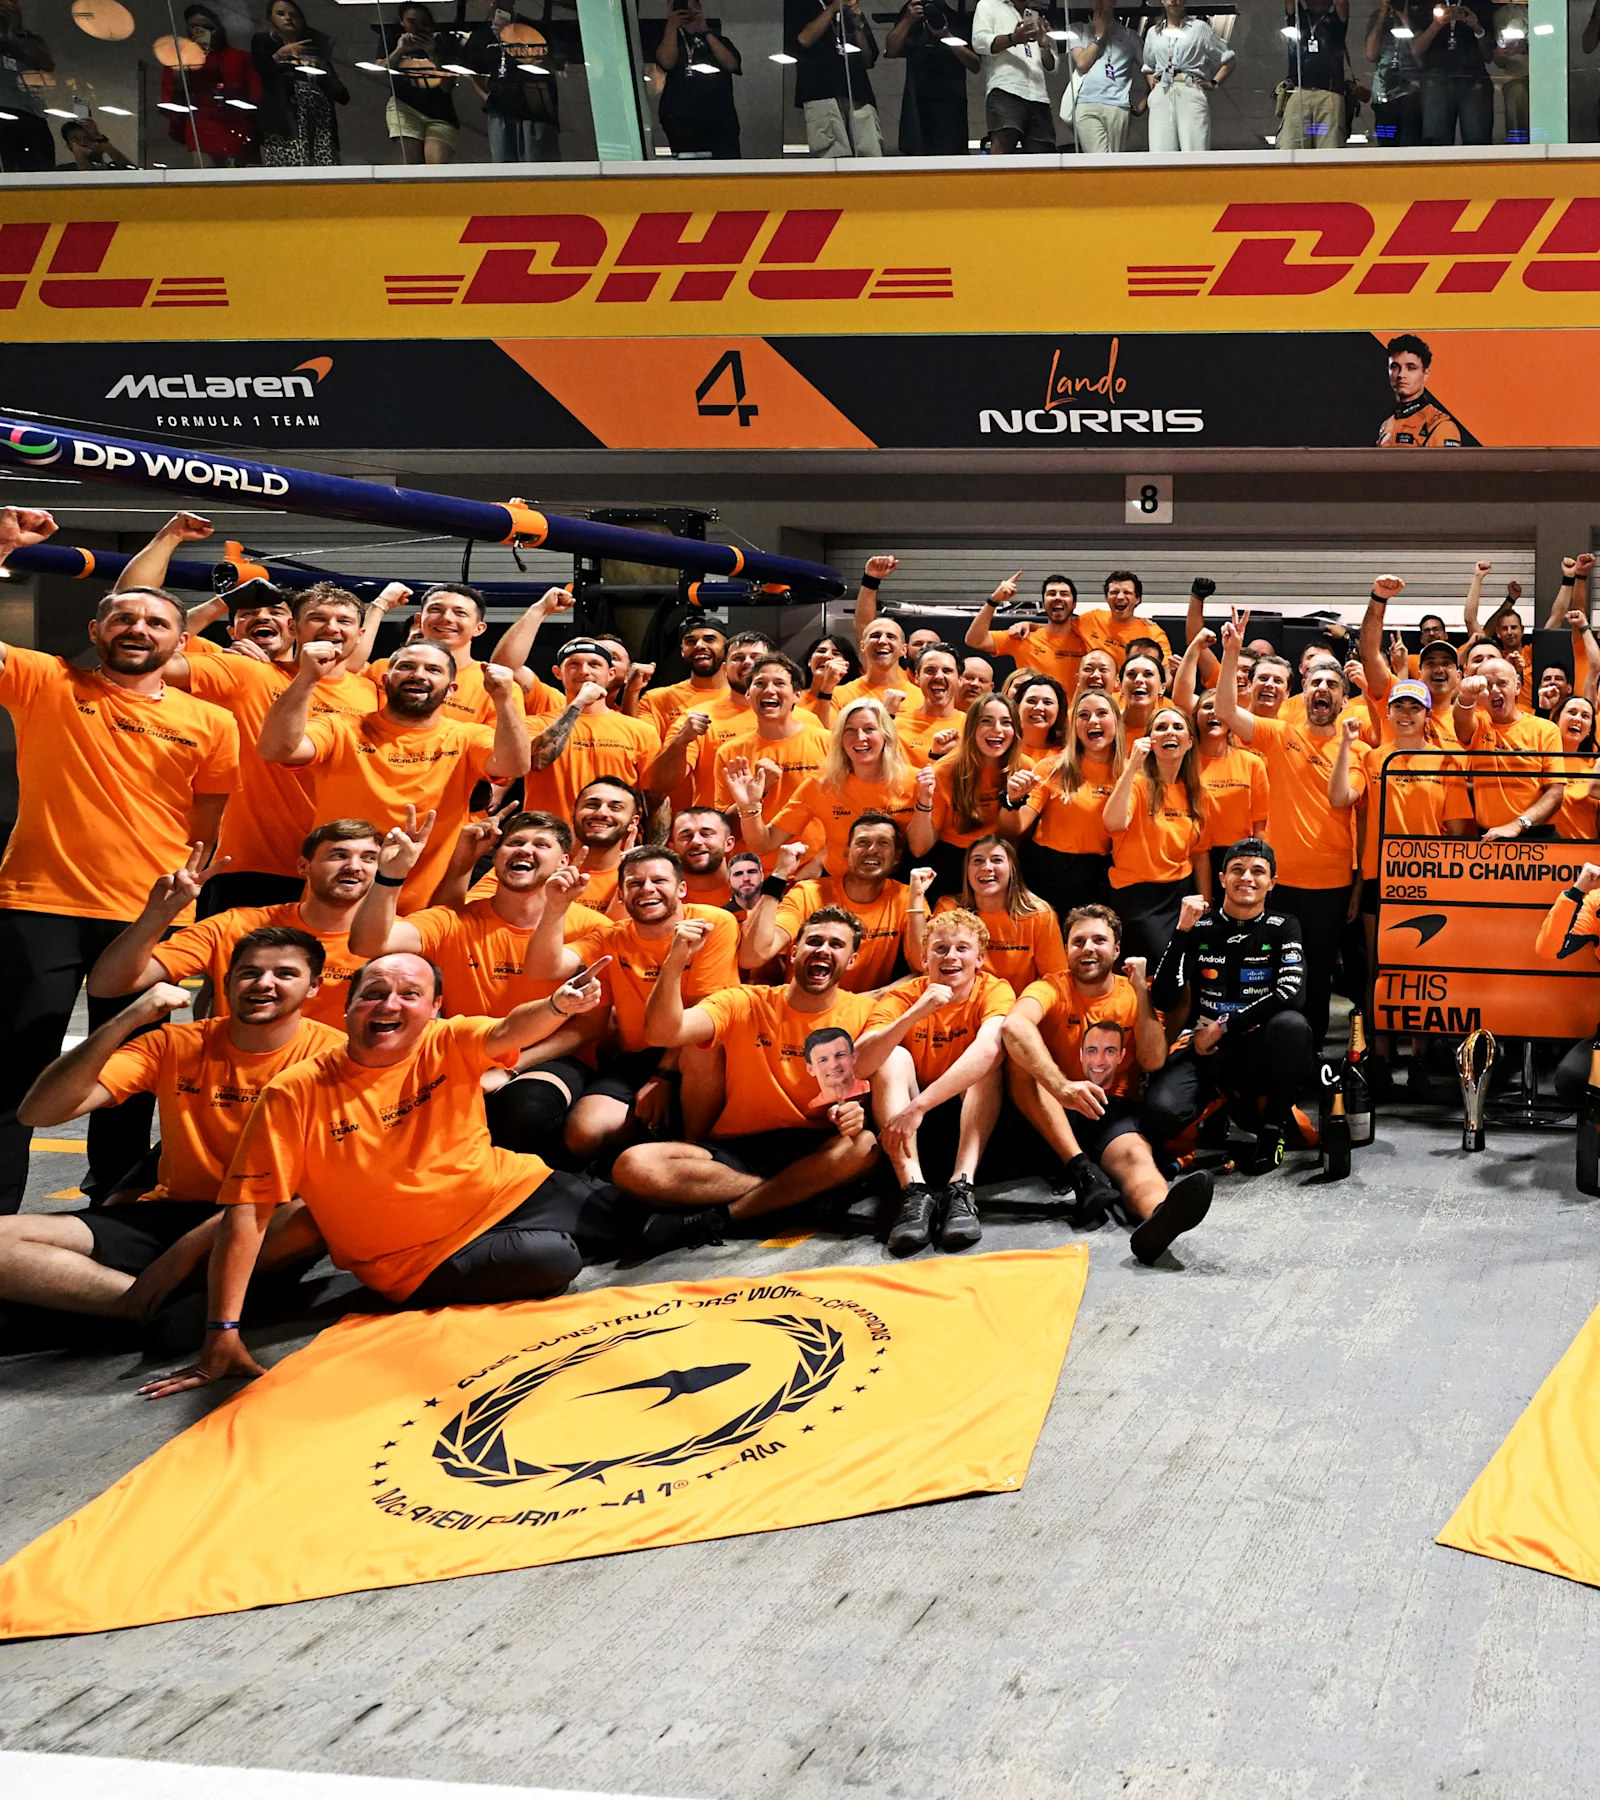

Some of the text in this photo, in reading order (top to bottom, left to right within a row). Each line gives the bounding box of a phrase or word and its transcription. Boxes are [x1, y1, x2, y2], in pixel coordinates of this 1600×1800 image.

[459, 209, 873, 305] DHL
[1045, 337, 1127, 411] Lando
[105, 373, 314, 399] McLaren
[696, 350, 759, 427] 4
[157, 415, 321, 428] FORMULA 1 TEAM
[979, 408, 1204, 434] NORRIS
[73, 439, 289, 497] DP WORLD
[1141, 485, 1158, 514] 8
[1387, 841, 1548, 861] CONSTRUCTORS'
[1386, 861, 1584, 882] WORLD CHAMPION
[1386, 885, 1427, 899] 2025
[1198, 954, 1226, 964] Android
[1243, 987, 1269, 996] allwyn
[1382, 973, 1447, 1001] THIS
[1200, 998, 1218, 1010] DELL
[1378, 1005, 1481, 1032] TEAM
[177, 1084, 200, 1095] TEAM
[215, 1092, 250, 1103] WORLD
[381, 1105, 413, 1122] WORLD
[330, 1124, 360, 1137] TEAM
